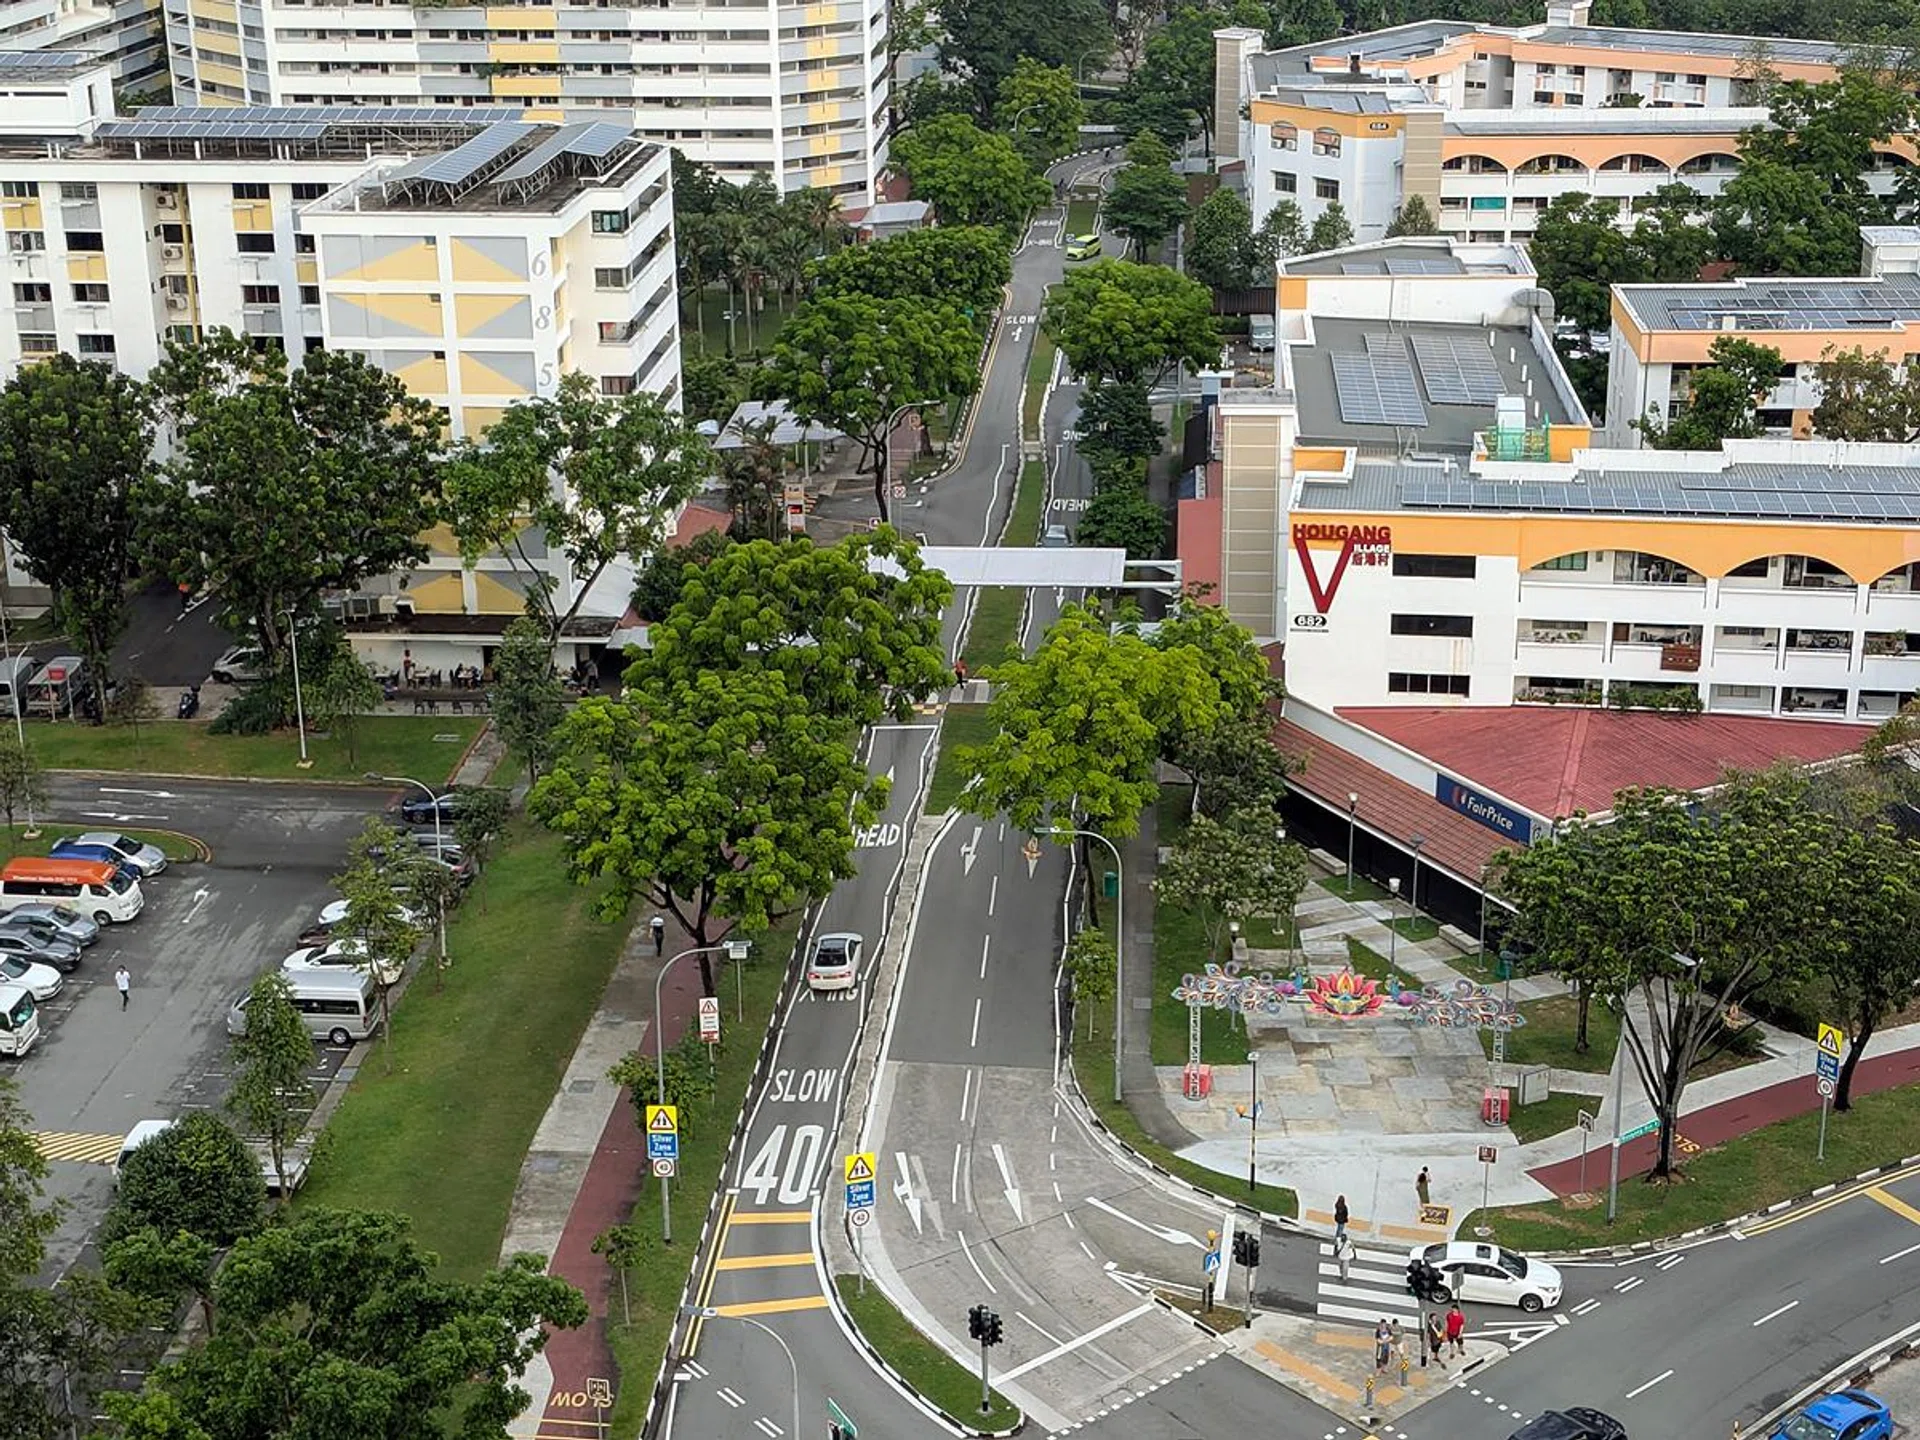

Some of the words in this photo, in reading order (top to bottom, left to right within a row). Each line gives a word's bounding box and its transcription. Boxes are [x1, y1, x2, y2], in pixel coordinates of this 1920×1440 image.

[1006, 315, 1037, 324] SLOW
[1293, 523, 1391, 543] HOUGANG
[1297, 615, 1323, 627] 682
[1467, 796, 1514, 831] FairPrice
[855, 823, 900, 848] HEAD
[771, 1068, 837, 1102] SLOW
[742, 1124, 824, 1205] 40
